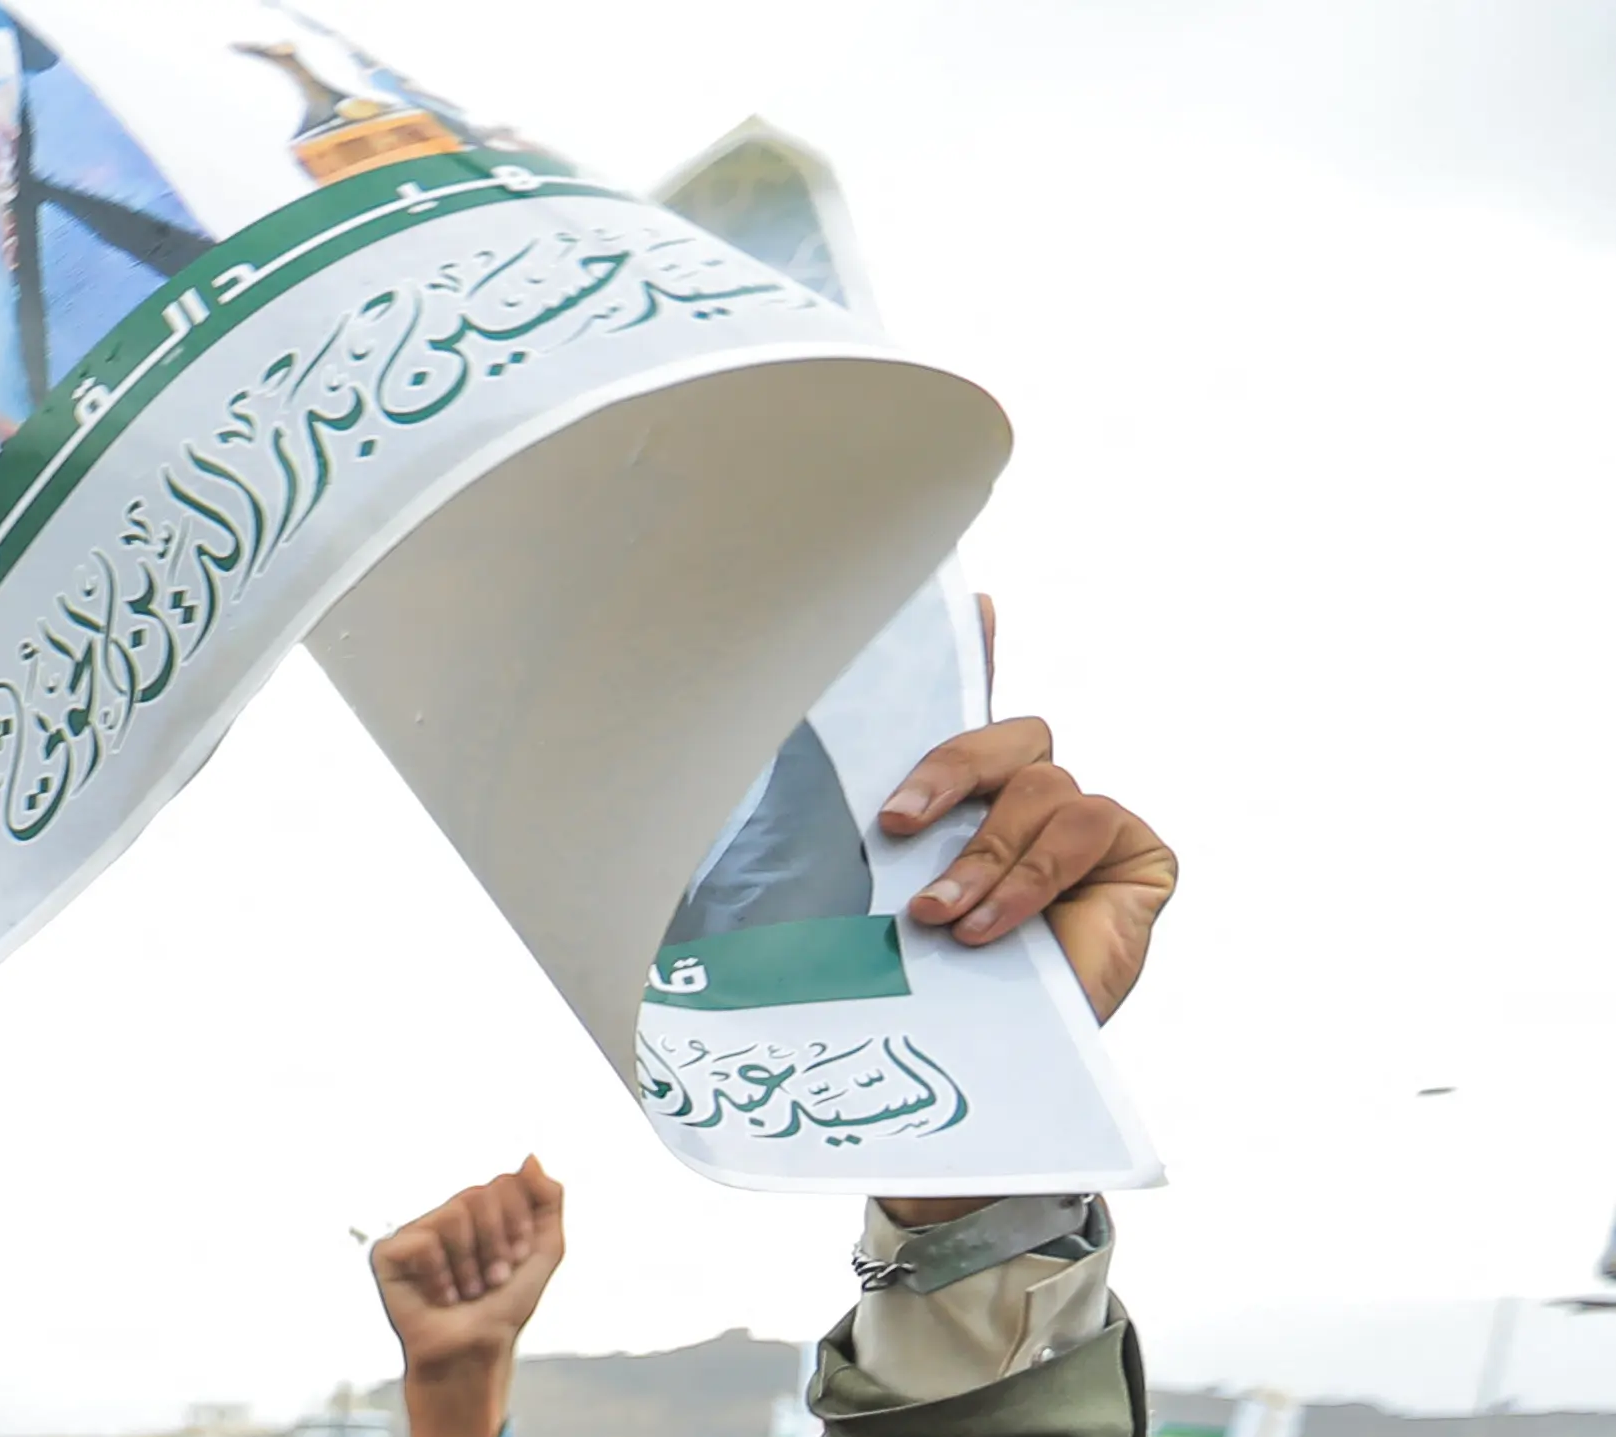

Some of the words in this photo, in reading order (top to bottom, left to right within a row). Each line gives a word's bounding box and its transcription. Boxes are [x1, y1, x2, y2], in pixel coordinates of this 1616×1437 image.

[212, 164, 601, 305] هيد
[375, 235, 633, 426] حسين
[254, 340, 375, 577] بدر
[93, 440, 265, 703] الدين
[751, 1036, 968, 1147] السيد
